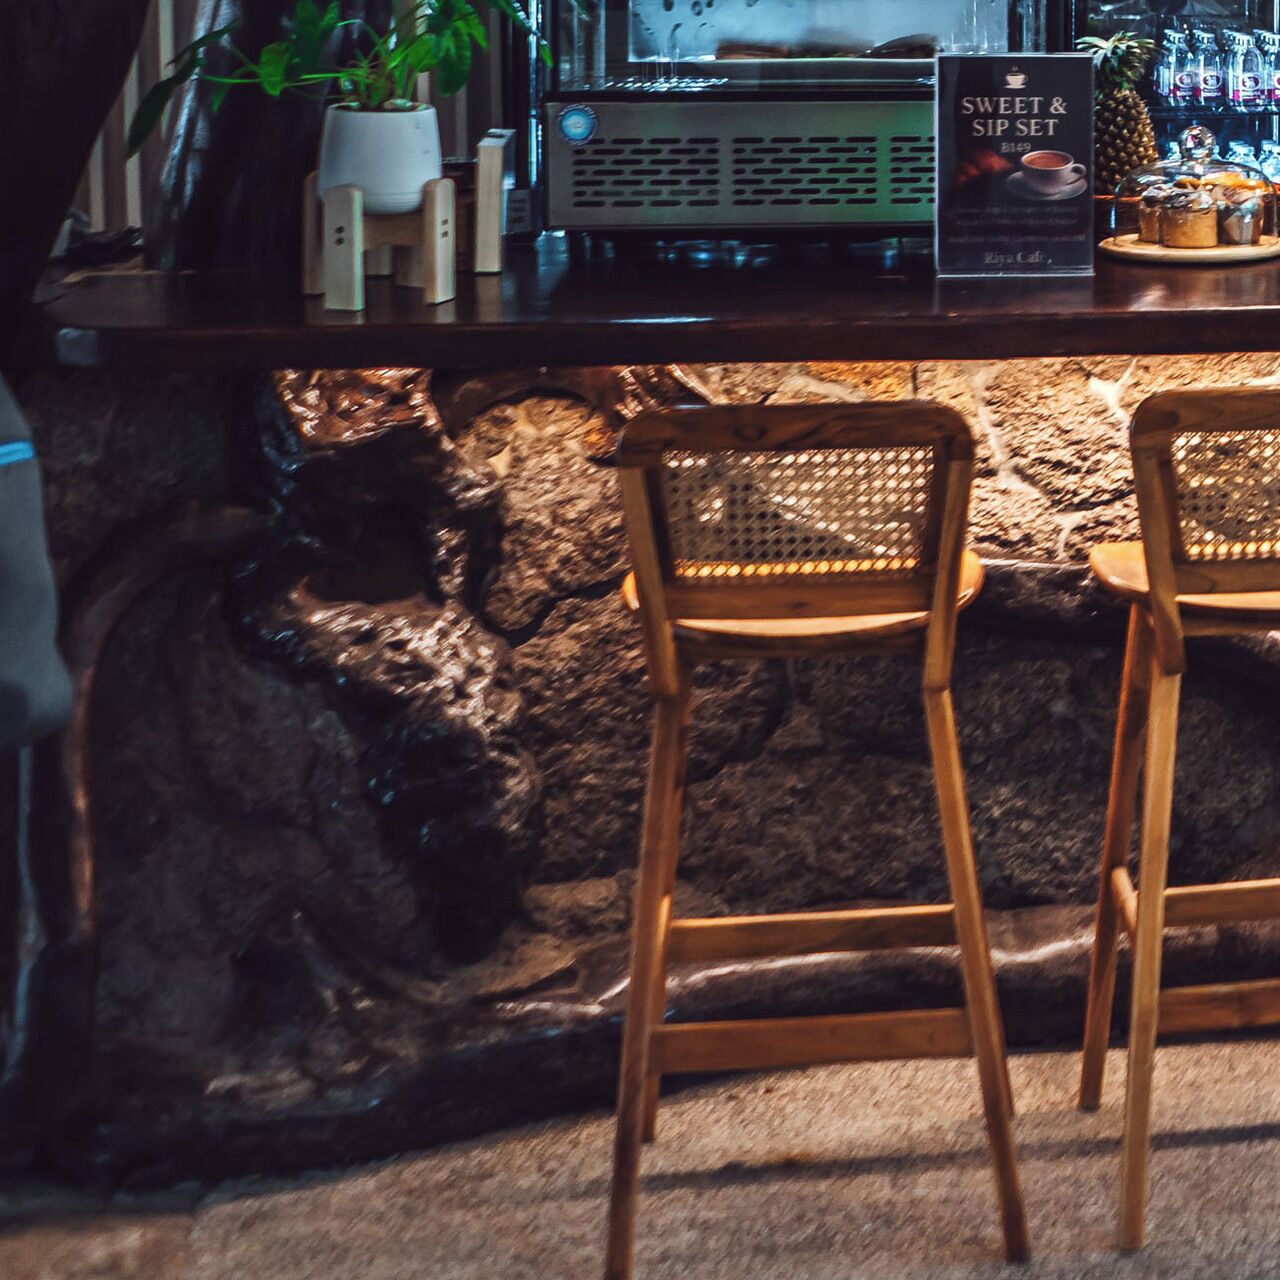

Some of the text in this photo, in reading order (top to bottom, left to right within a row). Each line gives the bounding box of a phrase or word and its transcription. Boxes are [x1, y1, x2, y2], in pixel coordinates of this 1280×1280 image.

[962, 96, 1068, 114] SWEET &
[972, 118, 1060, 137] SIP SET
